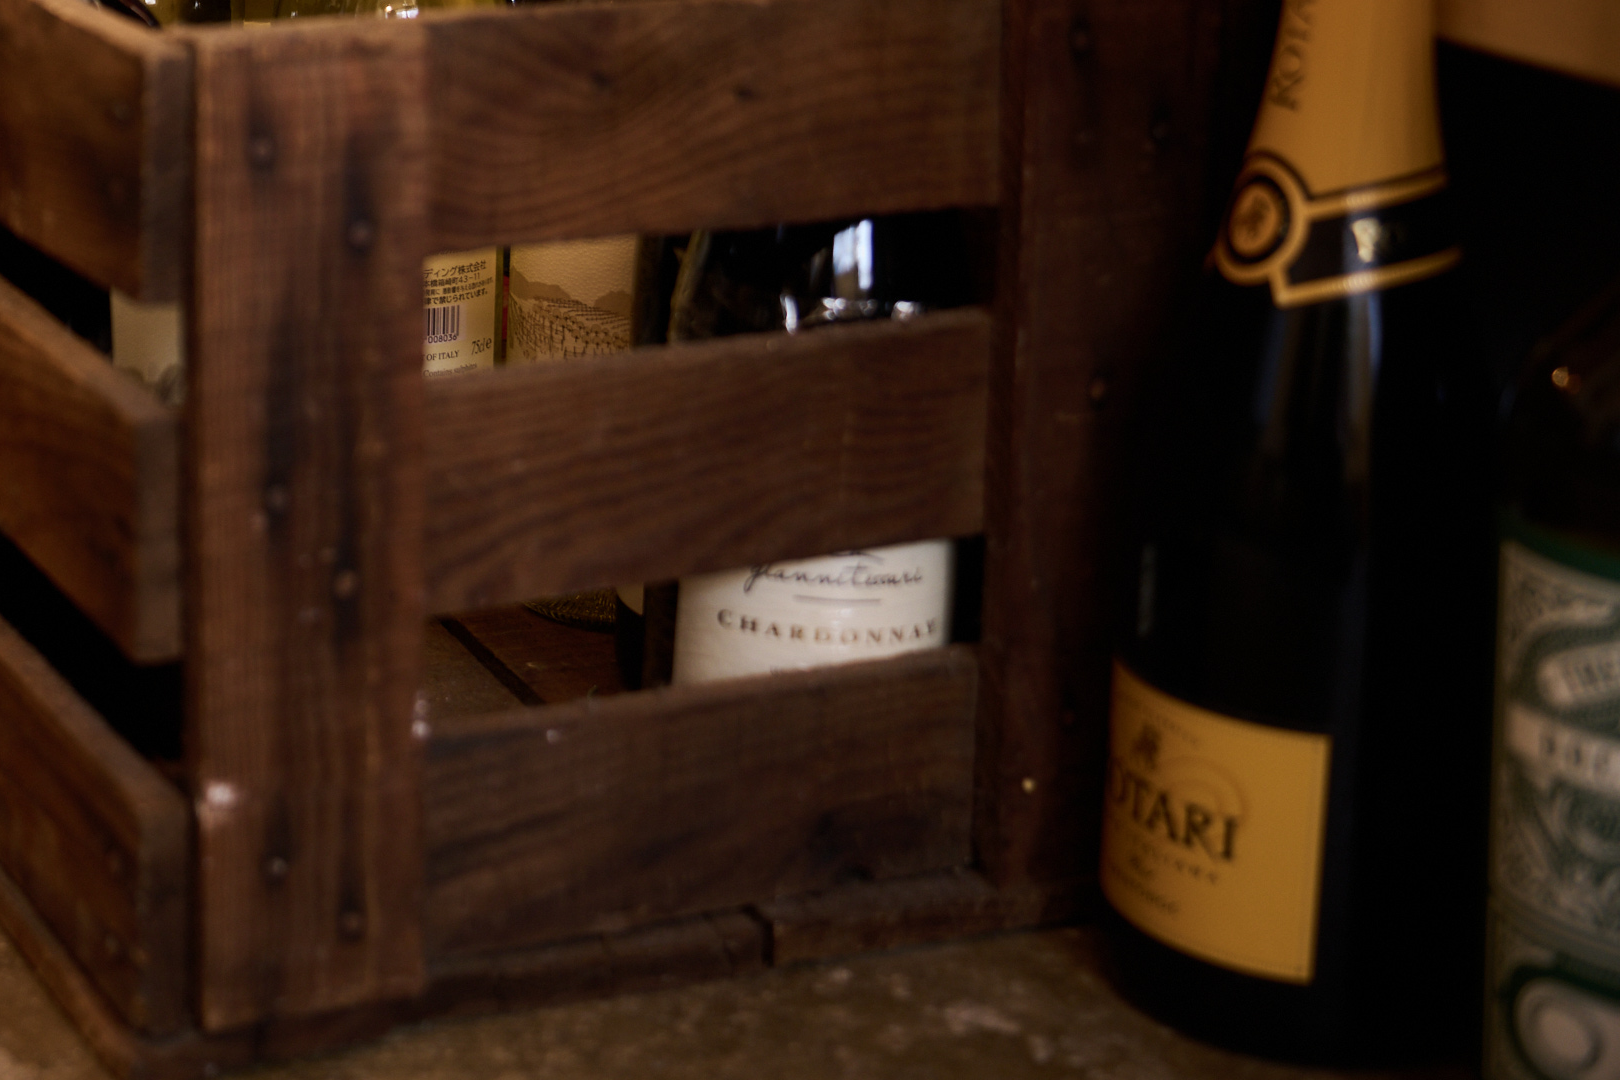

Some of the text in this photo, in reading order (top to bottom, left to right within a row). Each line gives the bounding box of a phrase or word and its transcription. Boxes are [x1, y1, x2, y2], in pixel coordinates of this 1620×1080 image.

[428, 333, 457, 344] 008036
[426, 353, 437, 361] OF
[438, 350, 459, 360] ITALY
